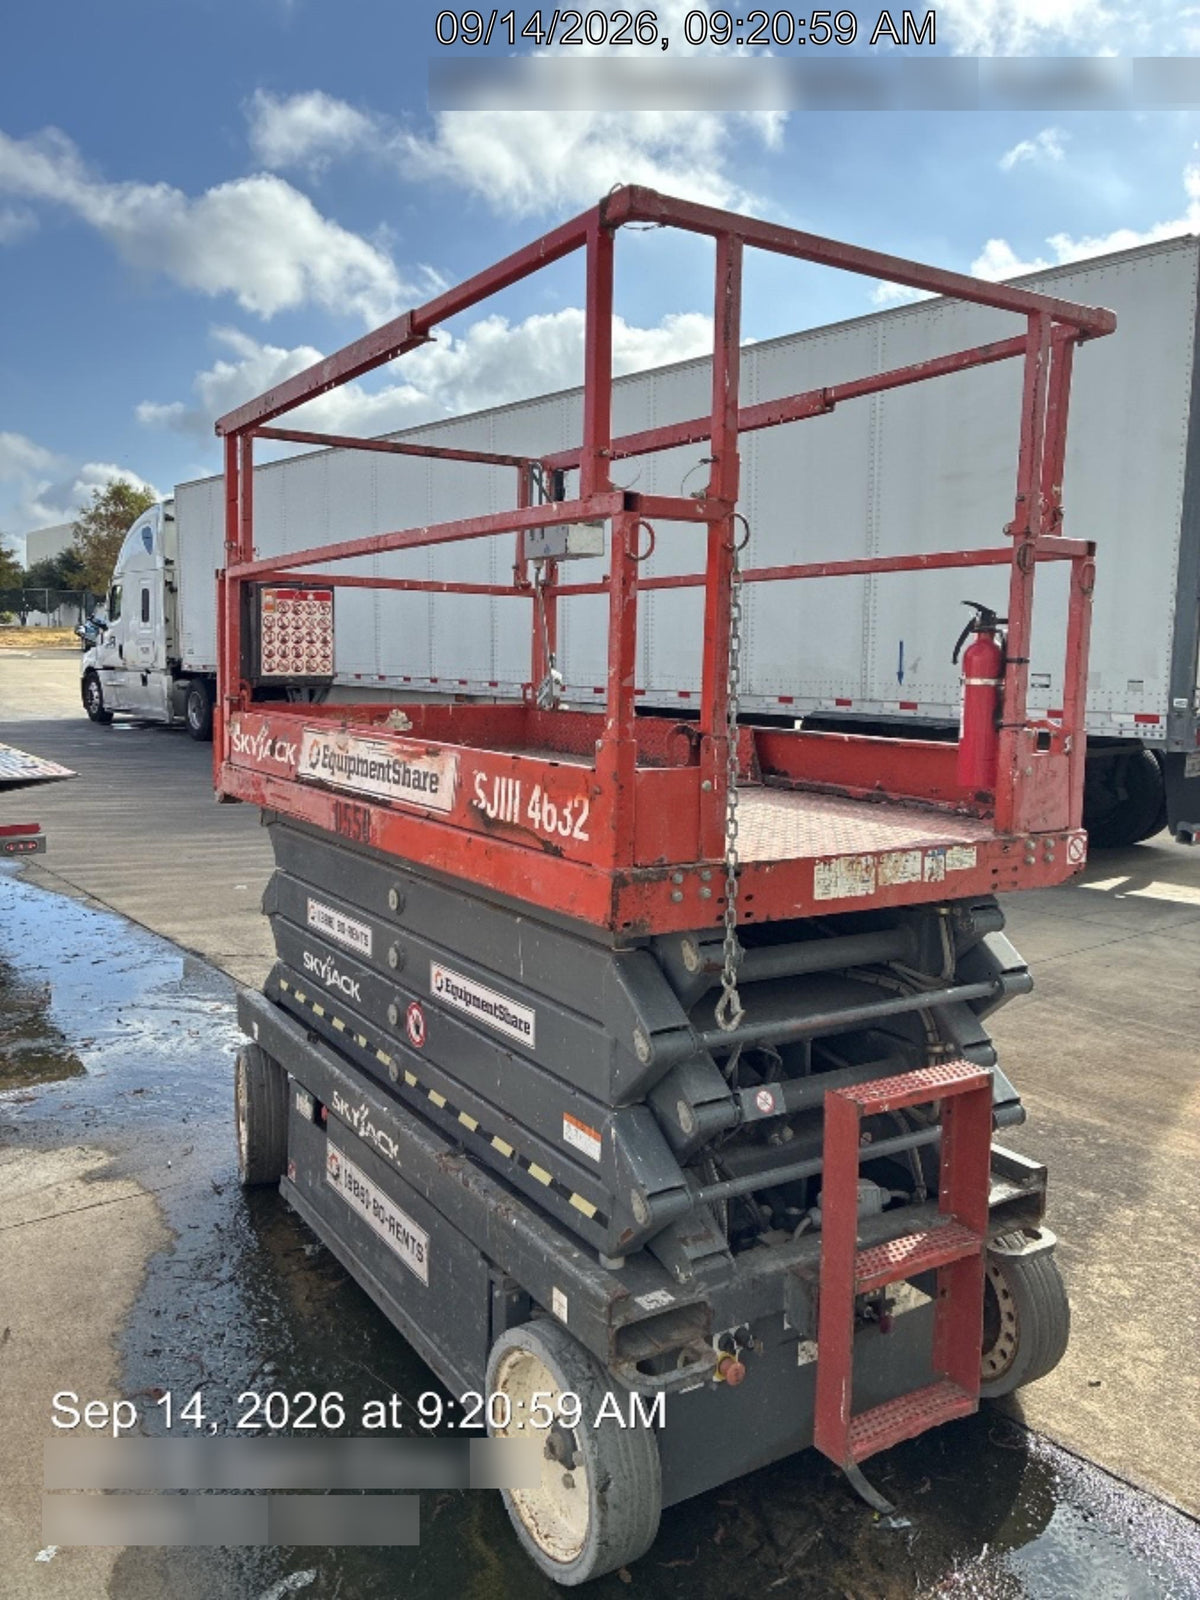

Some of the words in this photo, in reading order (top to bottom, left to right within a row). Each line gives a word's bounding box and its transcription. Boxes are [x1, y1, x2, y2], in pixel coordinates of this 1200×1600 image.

[232, 720, 297, 766] SKYJACK
[320, 744, 440, 794] EquipmentShare
[303, 951, 361, 1002] SKYJACK
[444, 977, 531, 1036] EquipmentShare
